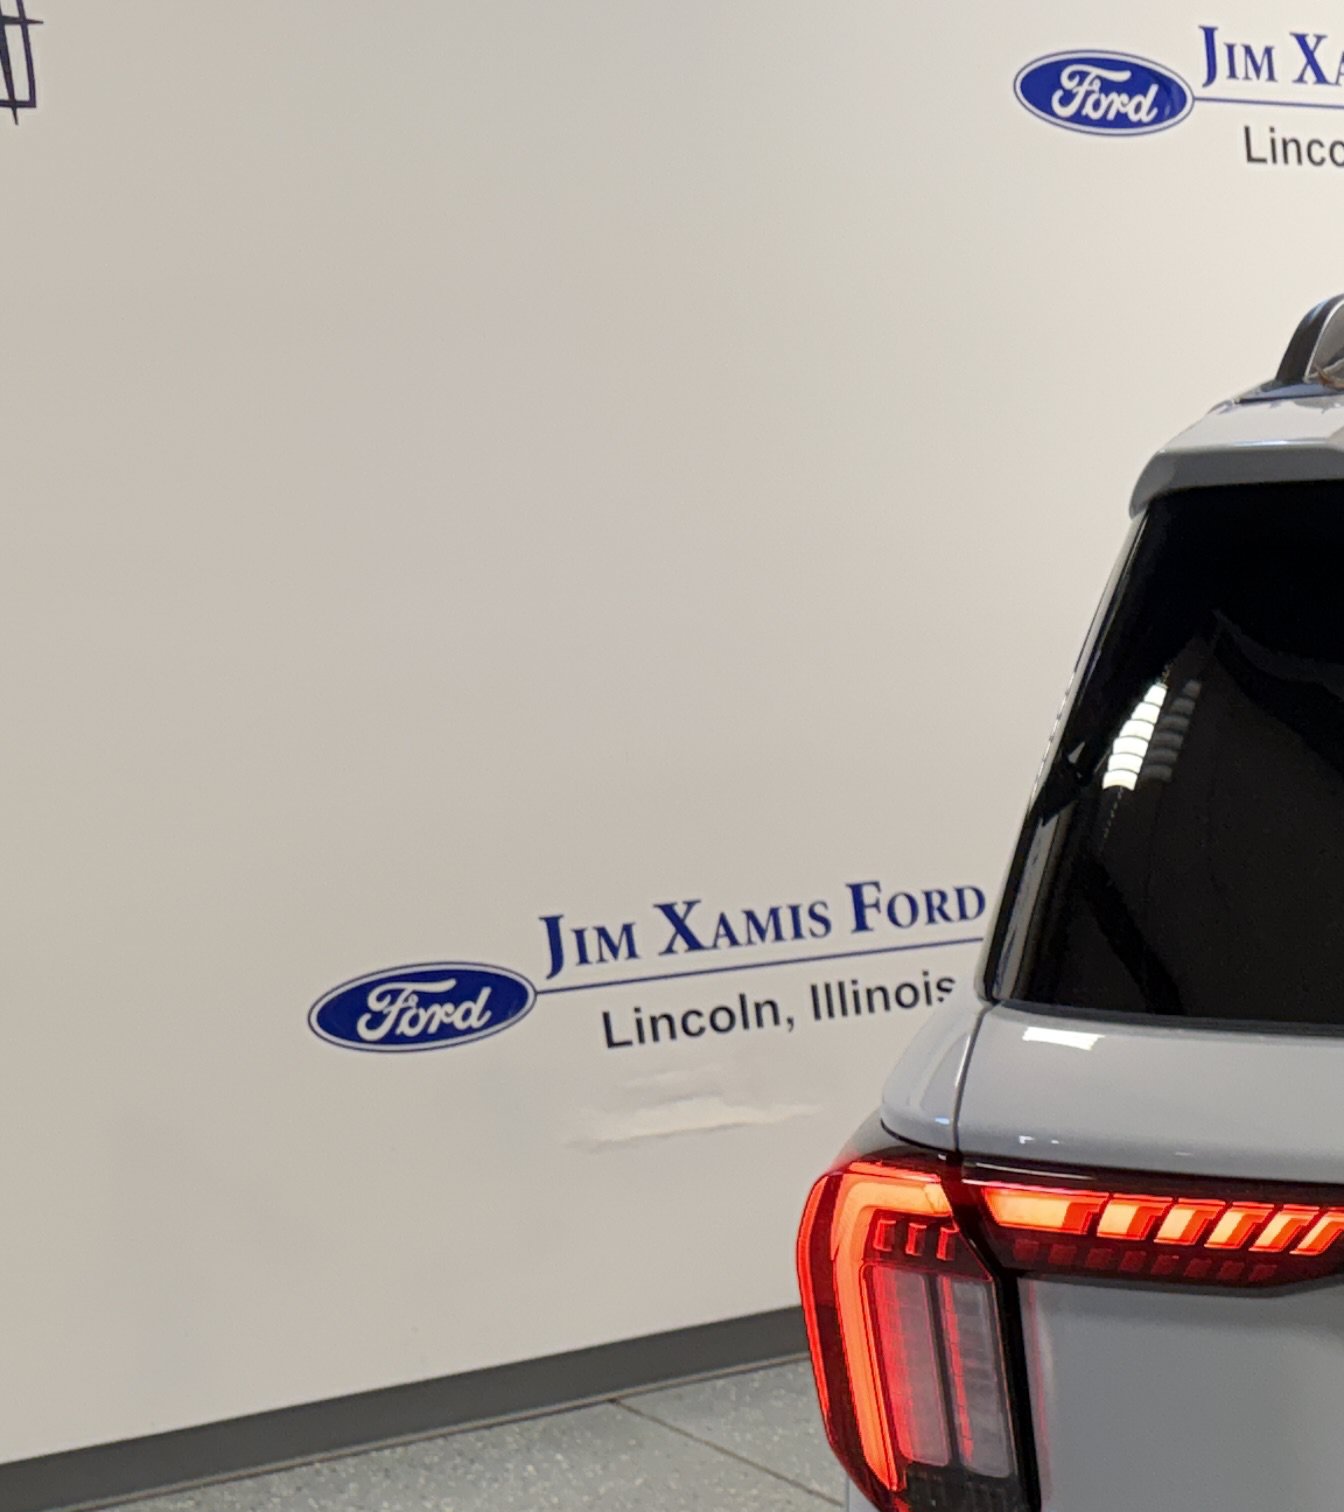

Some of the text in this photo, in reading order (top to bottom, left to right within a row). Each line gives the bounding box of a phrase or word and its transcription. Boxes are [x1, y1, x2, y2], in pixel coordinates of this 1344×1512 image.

[1198, 25, 1276, 88] JIM
[1051, 63, 1158, 123] Ford
[539, 880, 987, 980] JIM XAMIS FORD
[356, 978, 492, 1041] Ford
[601, 970, 956, 1050] Lincoln, Illinois
